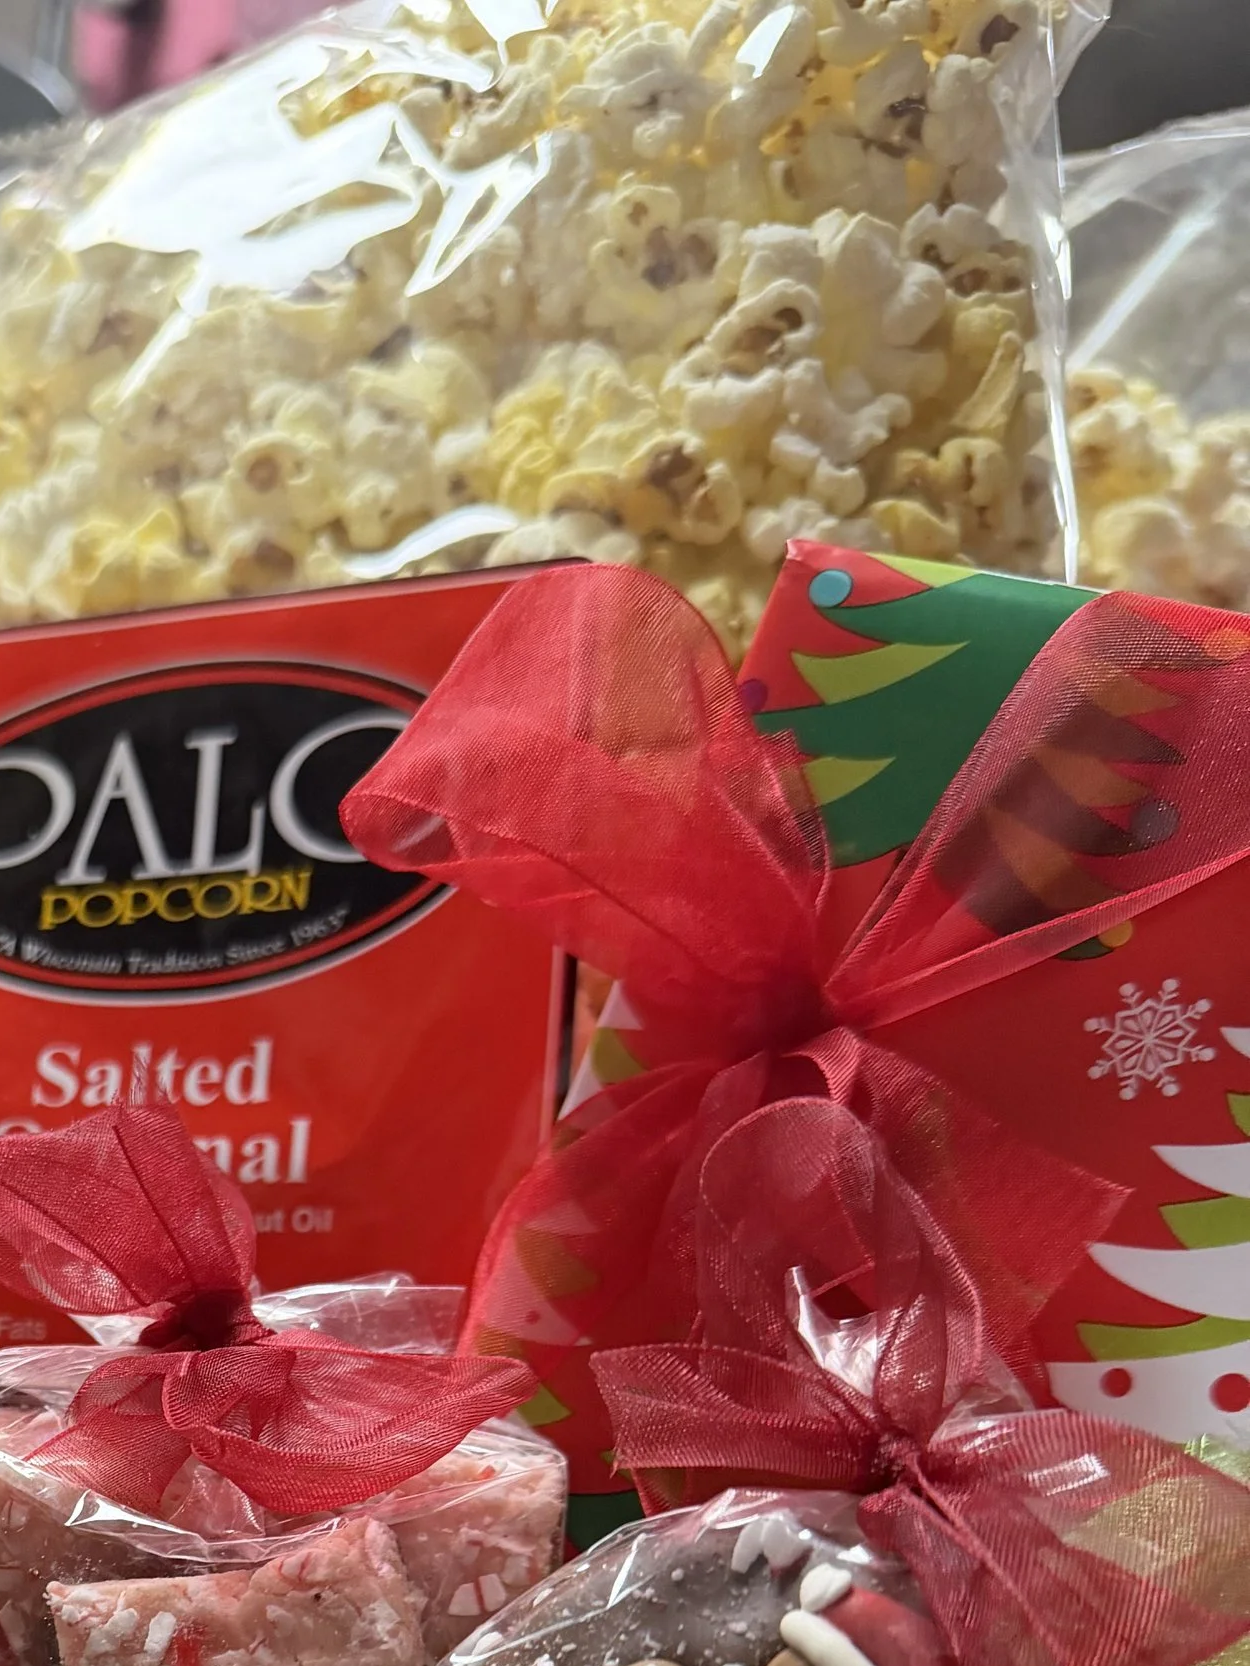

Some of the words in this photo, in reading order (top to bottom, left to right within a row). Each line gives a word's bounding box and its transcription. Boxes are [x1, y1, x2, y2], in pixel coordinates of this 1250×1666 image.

[39, 868, 313, 930] POPCORN
[31, 1035, 274, 1107] Salted
[291, 1205, 334, 1233] Oil
